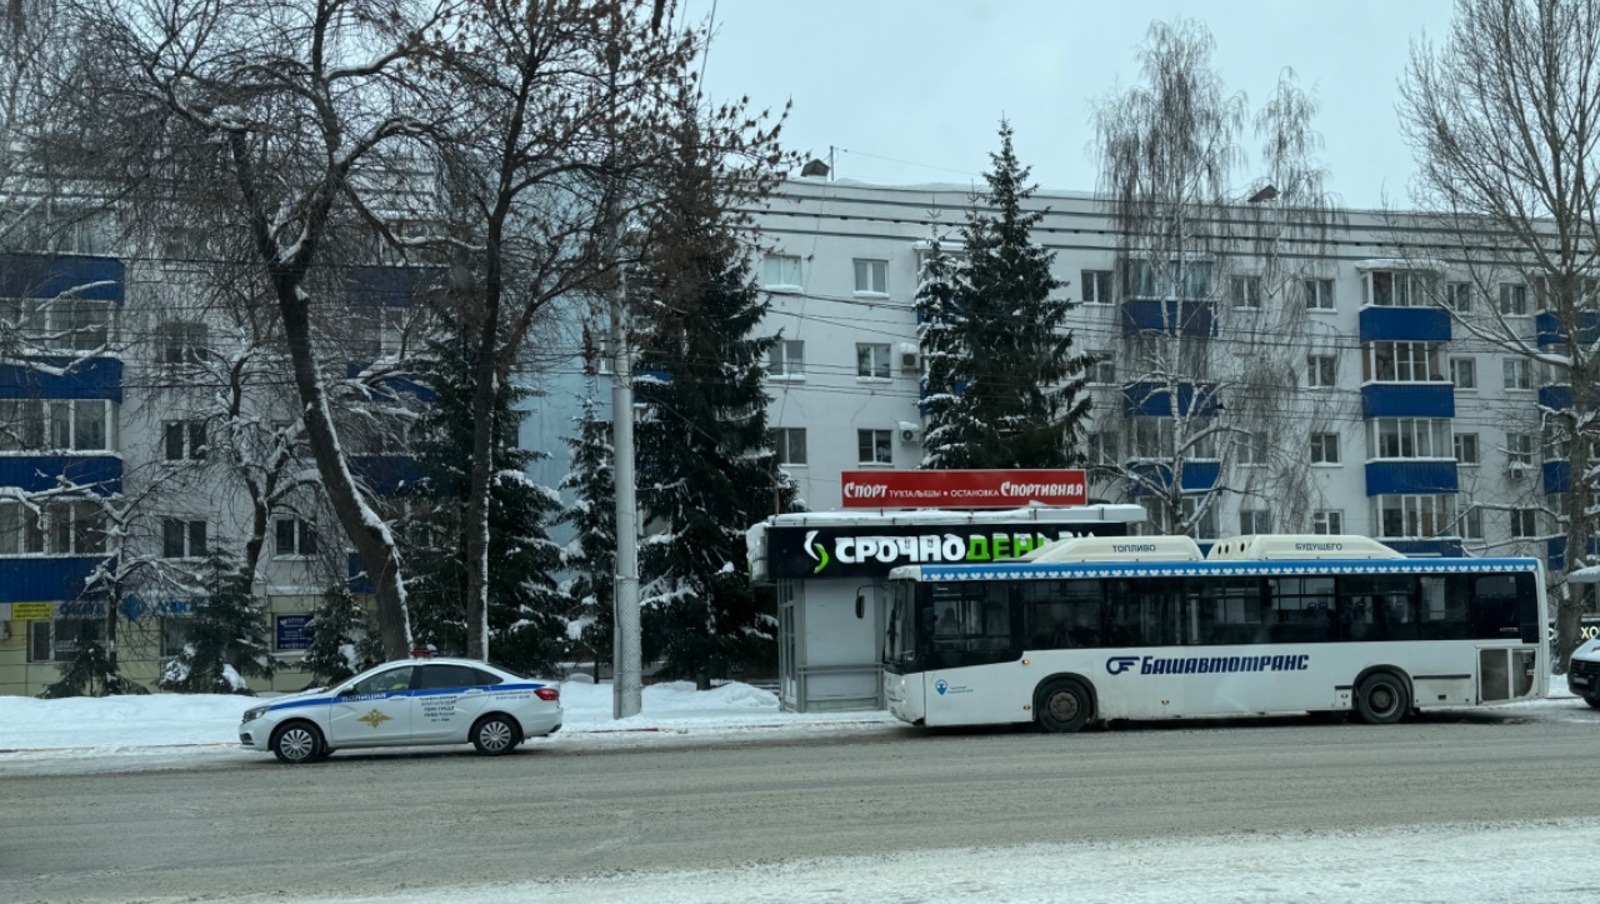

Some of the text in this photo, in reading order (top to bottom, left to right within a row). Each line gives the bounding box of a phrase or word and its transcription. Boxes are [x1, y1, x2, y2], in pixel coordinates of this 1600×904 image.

[950, 489, 999, 498] ОСТАНОВКА
[835, 531, 1095, 563] СРОЧНОДЕН
[1112, 544, 1156, 553] ТОПЛИВО
[1295, 543, 1343, 551] БУДУЩЕГО
